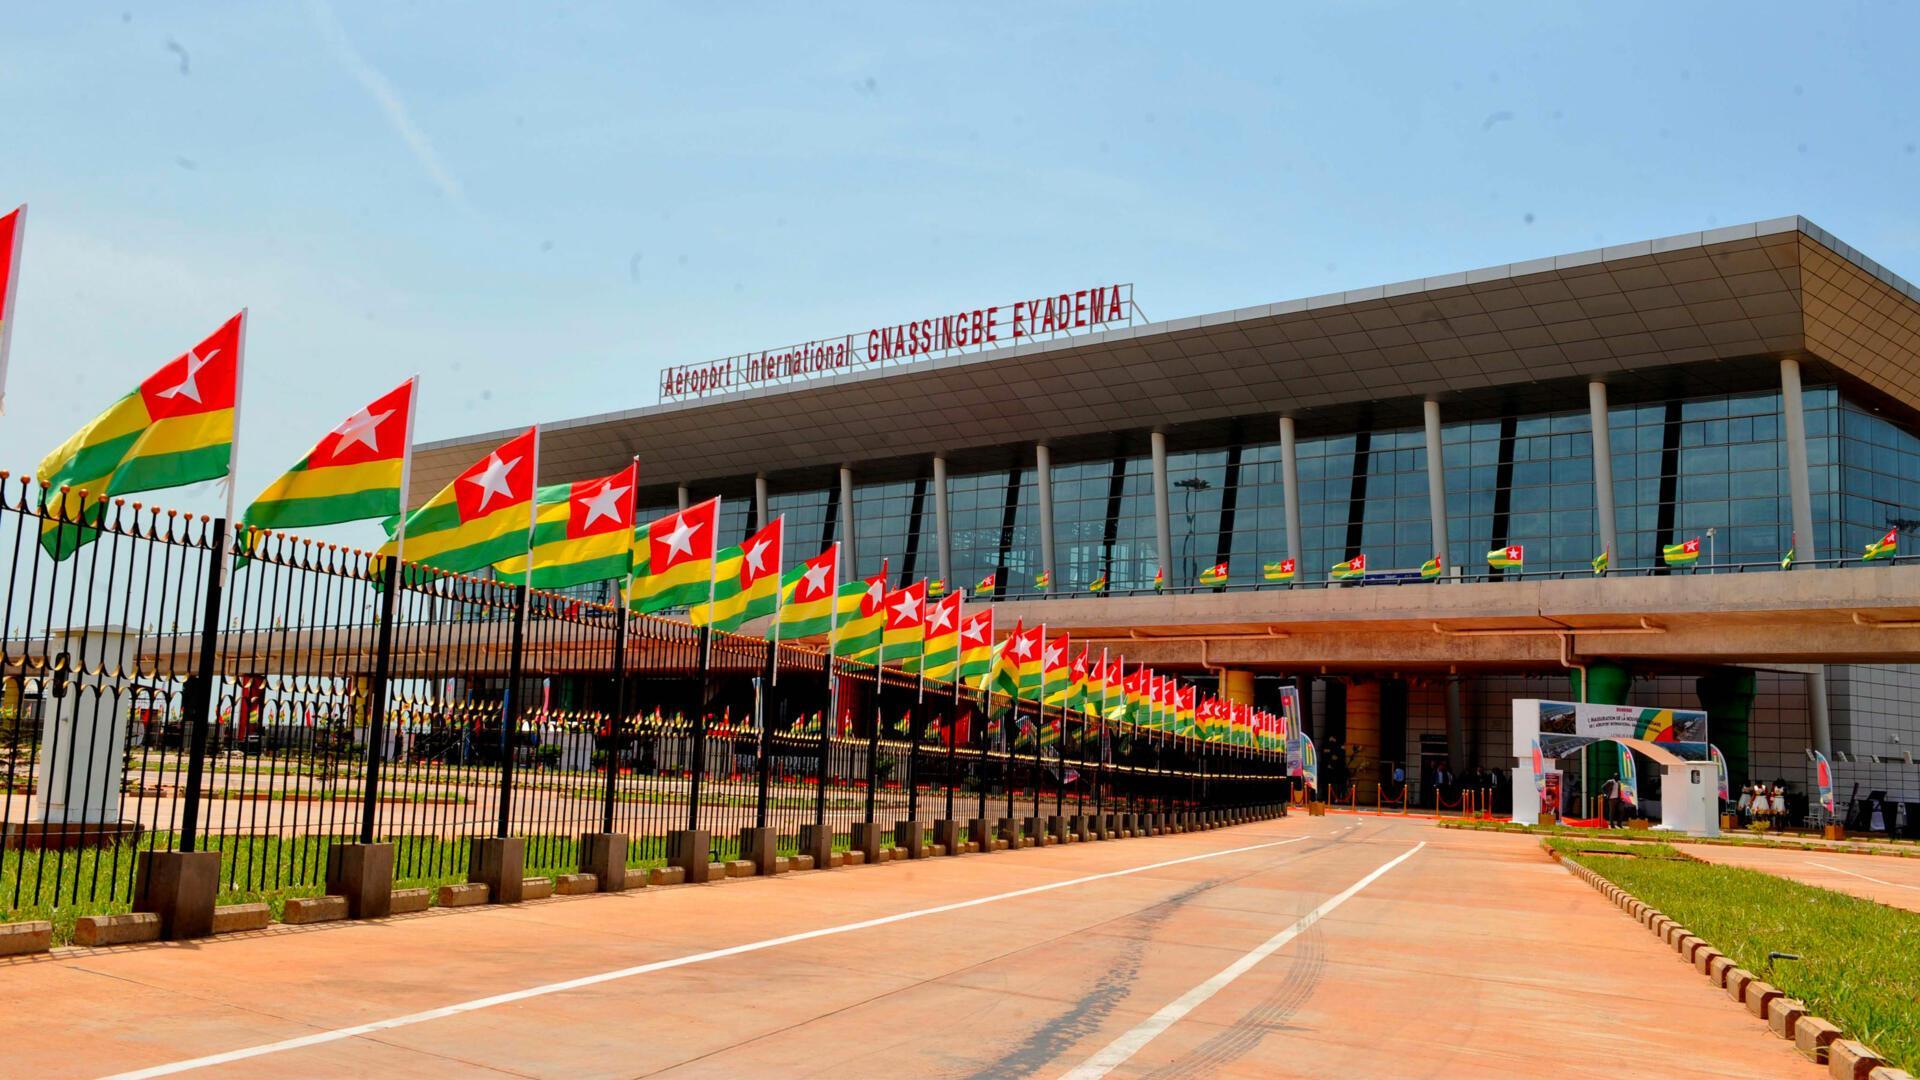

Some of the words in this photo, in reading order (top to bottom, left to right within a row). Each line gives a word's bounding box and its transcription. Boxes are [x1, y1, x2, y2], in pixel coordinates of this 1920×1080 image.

[665, 357, 732, 398] Aéroport
[745, 334, 851, 384] International
[867, 307, 998, 362] GNASSINGBE
[1013, 284, 1122, 338] EYADEMA
